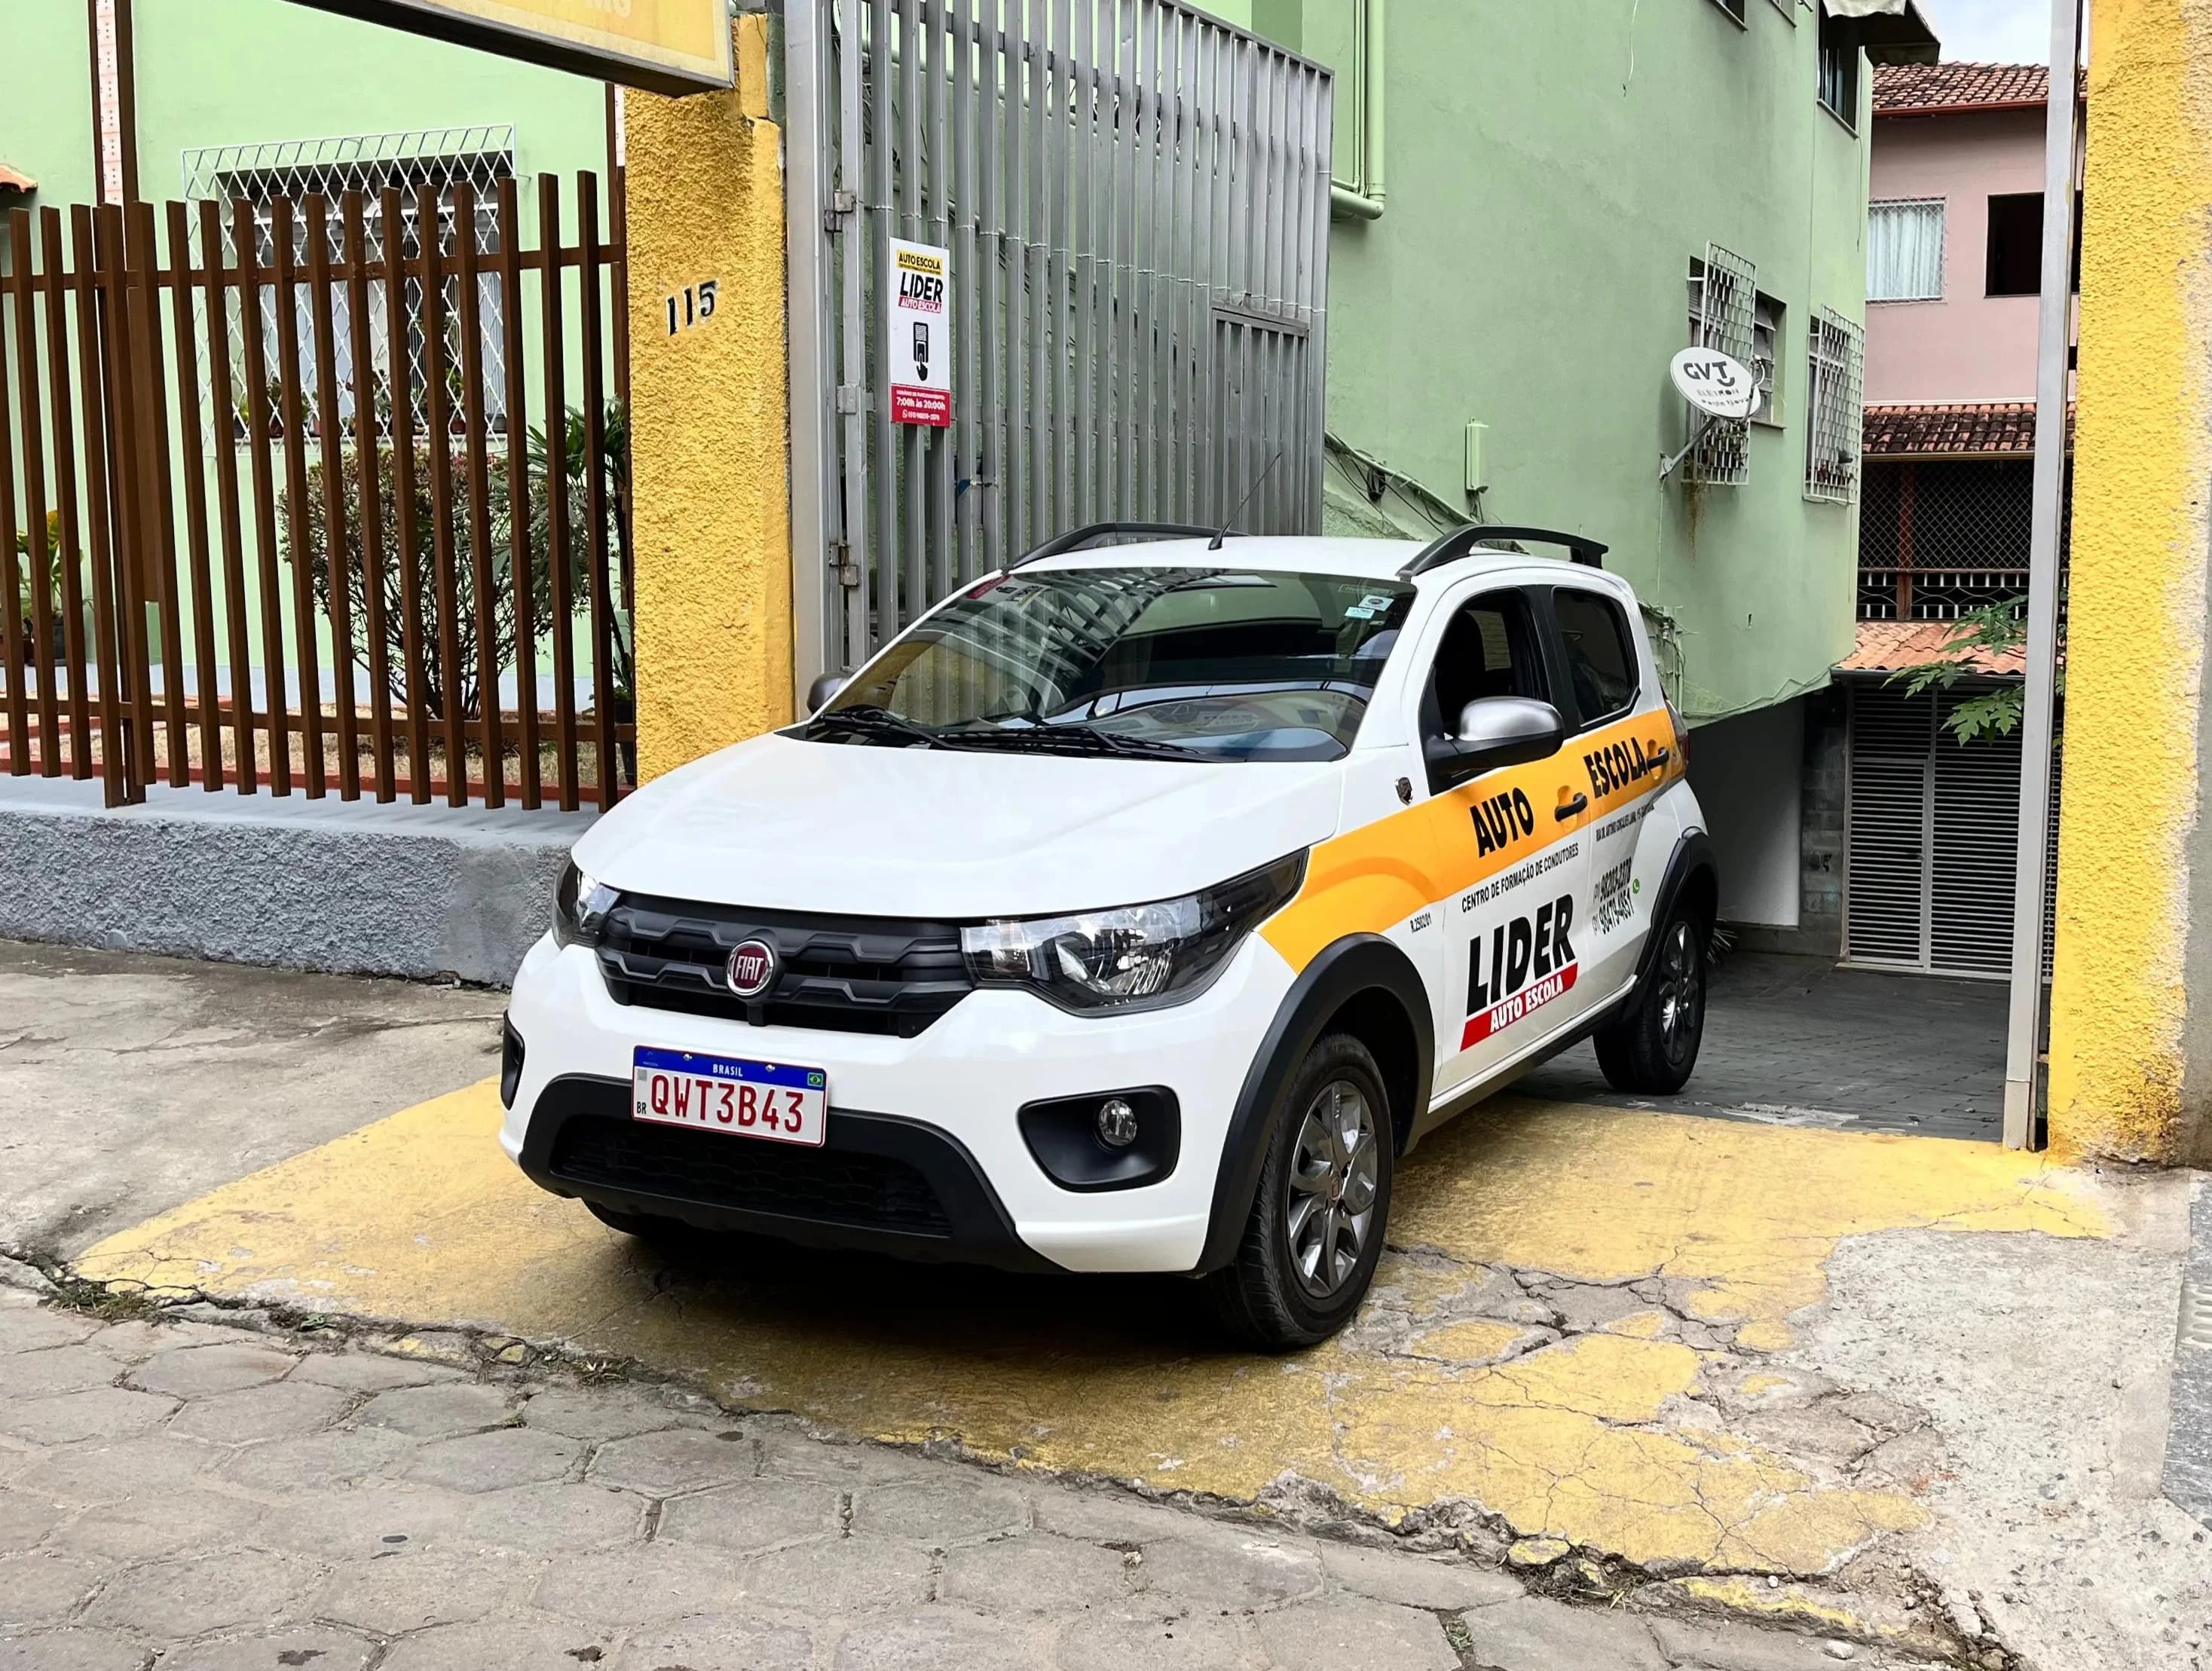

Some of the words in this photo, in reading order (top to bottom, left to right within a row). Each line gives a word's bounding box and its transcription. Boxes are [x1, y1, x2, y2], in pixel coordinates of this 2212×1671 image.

[898, 252, 916, 265] AUTO
[916, 256, 941, 271] ESCOLA
[900, 271, 944, 303] LIDER
[667, 280, 717, 337] 115
[901, 298, 918, 310] AUTO
[918, 300, 941, 313] ESCOLA
[1683, 361, 1733, 385] GVT
[896, 396, 915, 407] 7:00h
[923, 399, 946, 411] 20:00h
[1468, 787, 1534, 858] AUTO
[1583, 736, 1648, 799] ESCOLA
[1461, 886, 1489, 914] CENTRO
[1491, 880, 1500, 899] DE
[1501, 862, 1534, 893] FORMAÇÃO
[1535, 859, 1544, 877] DE
[1544, 842, 1579, 873] CONDUTORES
[734, 955, 764, 981] FIAT
[1466, 892, 1576, 1017] LIDER
[1490, 999, 1523, 1033] AUTO
[1525, 974, 1564, 1012] ESCOLA
[712, 1063, 743, 1077] BRASIL
[636, 1100, 647, 1115] BR
[651, 1074, 804, 1133] QWT3B43
